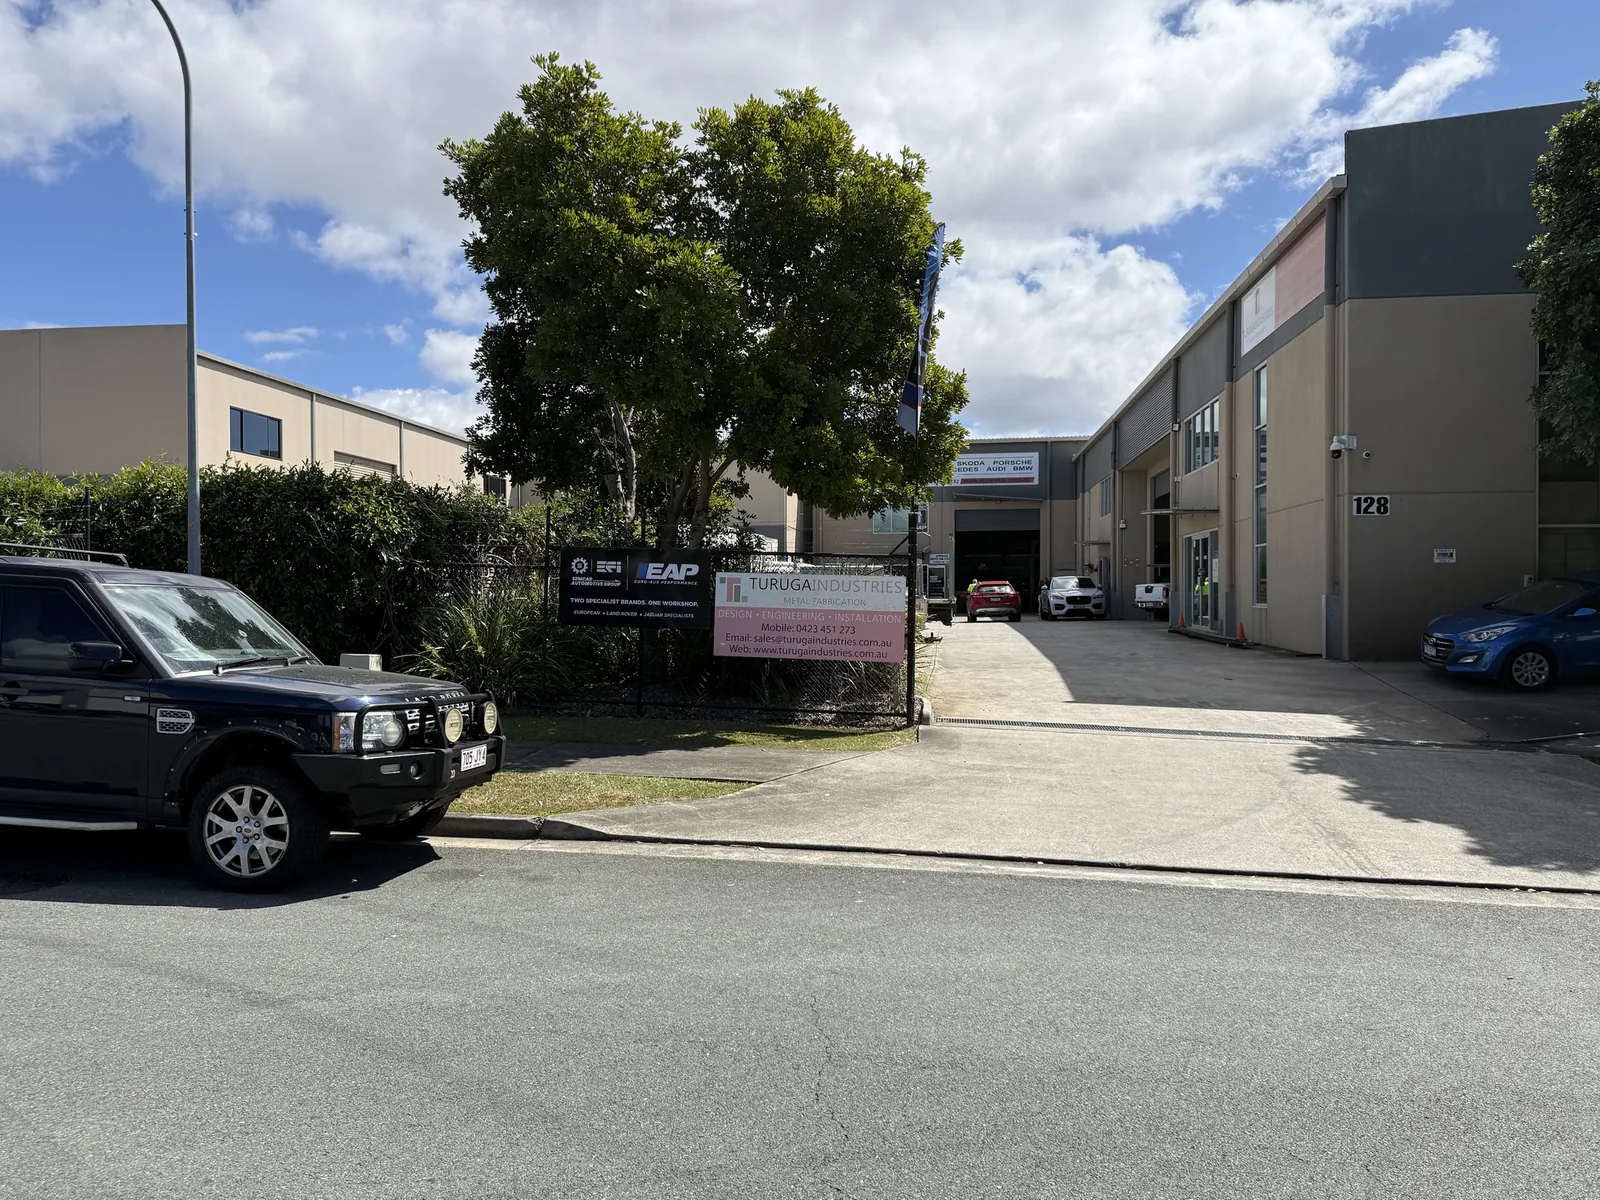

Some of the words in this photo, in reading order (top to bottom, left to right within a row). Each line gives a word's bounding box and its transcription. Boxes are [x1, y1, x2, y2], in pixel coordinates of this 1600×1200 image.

[1354, 497, 1389, 514] 128
[646, 563, 699, 580] EAP
[783, 597, 810, 605] METAL
[812, 598, 867, 607] FABRICATION
[718, 609, 753, 619] DESIGN
[762, 611, 825, 621] ENGINEERING
[834, 613, 902, 624] INSTALLATION
[761, 623, 795, 633] Mobile:
[796, 624, 818, 634] 0423
[820, 625, 836, 634] 451
[839, 626, 856, 635] 273
[725, 633, 752, 642] Email:
[753, 634, 892, 648] sales@turugaindustries.com.au
[729, 644, 752, 654] Web:
[753, 647, 888, 659] www.turugaindustries.com.au
